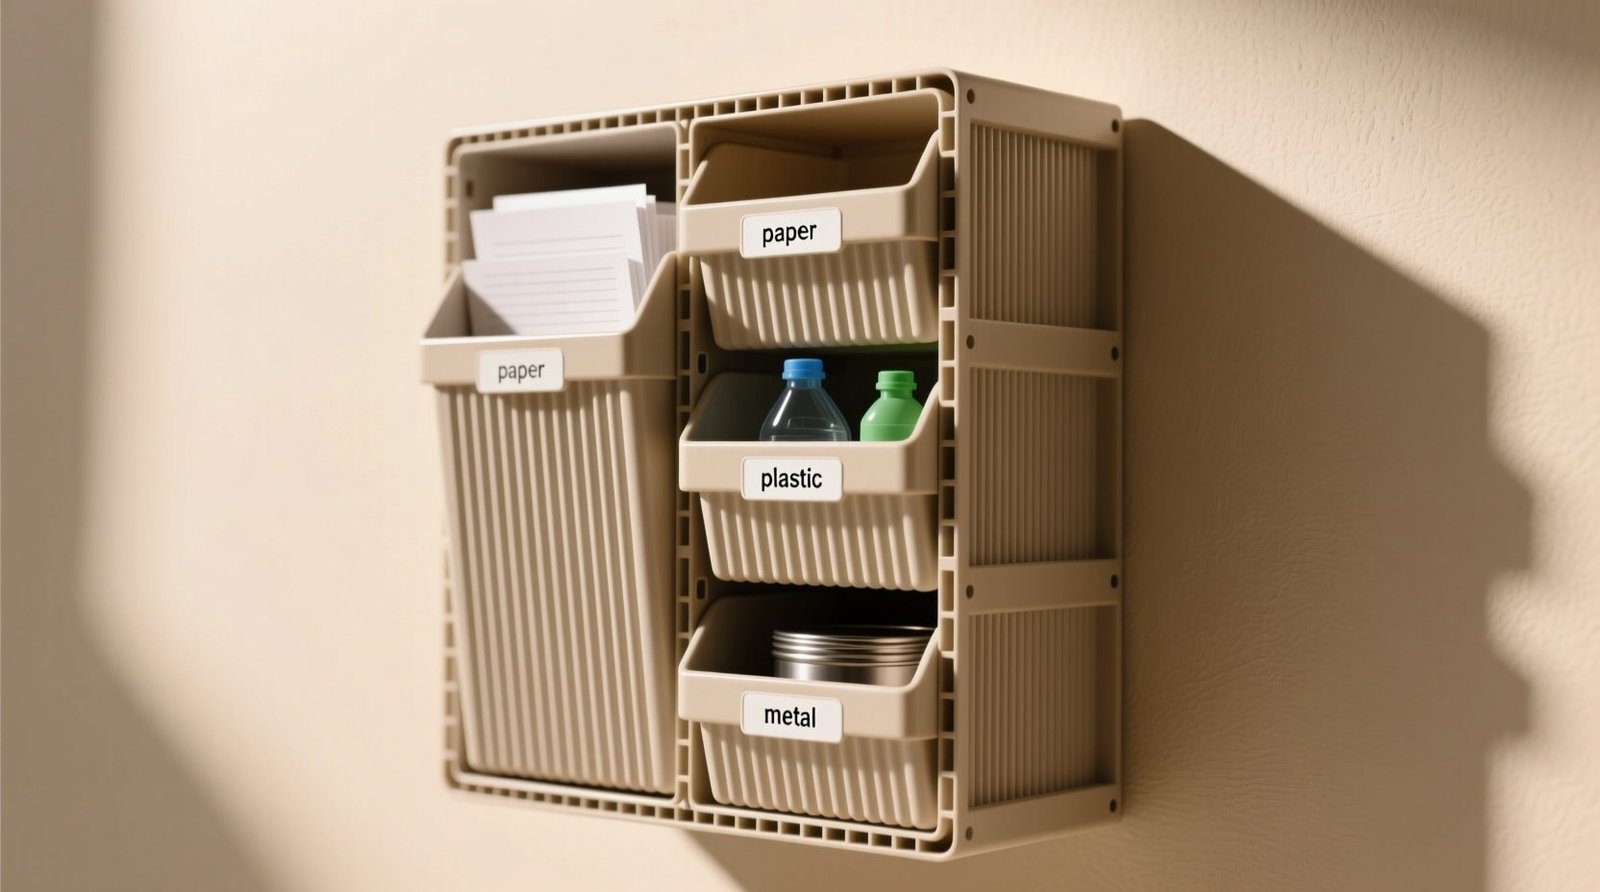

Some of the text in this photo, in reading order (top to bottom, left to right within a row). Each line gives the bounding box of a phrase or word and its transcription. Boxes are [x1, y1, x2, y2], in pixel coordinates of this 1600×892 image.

[761, 224, 818, 249] paper
[498, 363, 545, 384] paper
[761, 466, 823, 493] plastic
[764, 706, 816, 729] metal
